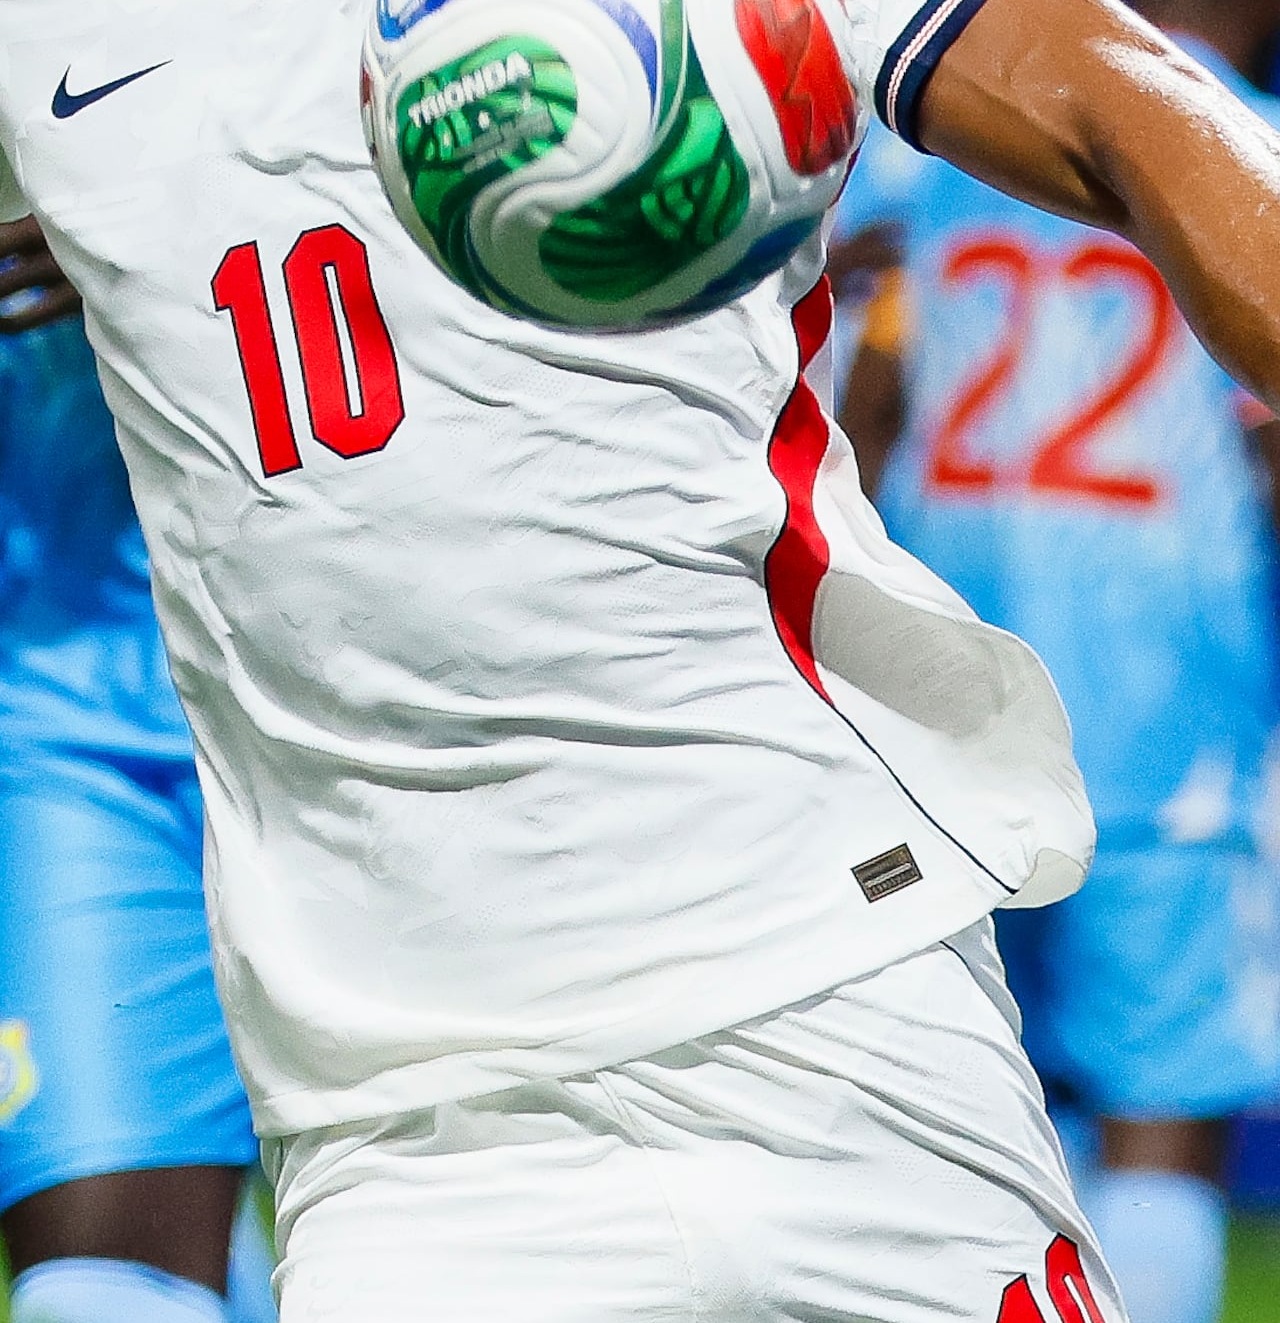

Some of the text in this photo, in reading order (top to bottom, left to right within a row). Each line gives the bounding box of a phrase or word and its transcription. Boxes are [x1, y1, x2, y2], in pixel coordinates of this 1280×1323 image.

[407, 49, 532, 129] TRIONDA
[210, 222, 406, 479] 10
[926, 235, 1173, 505] 22
